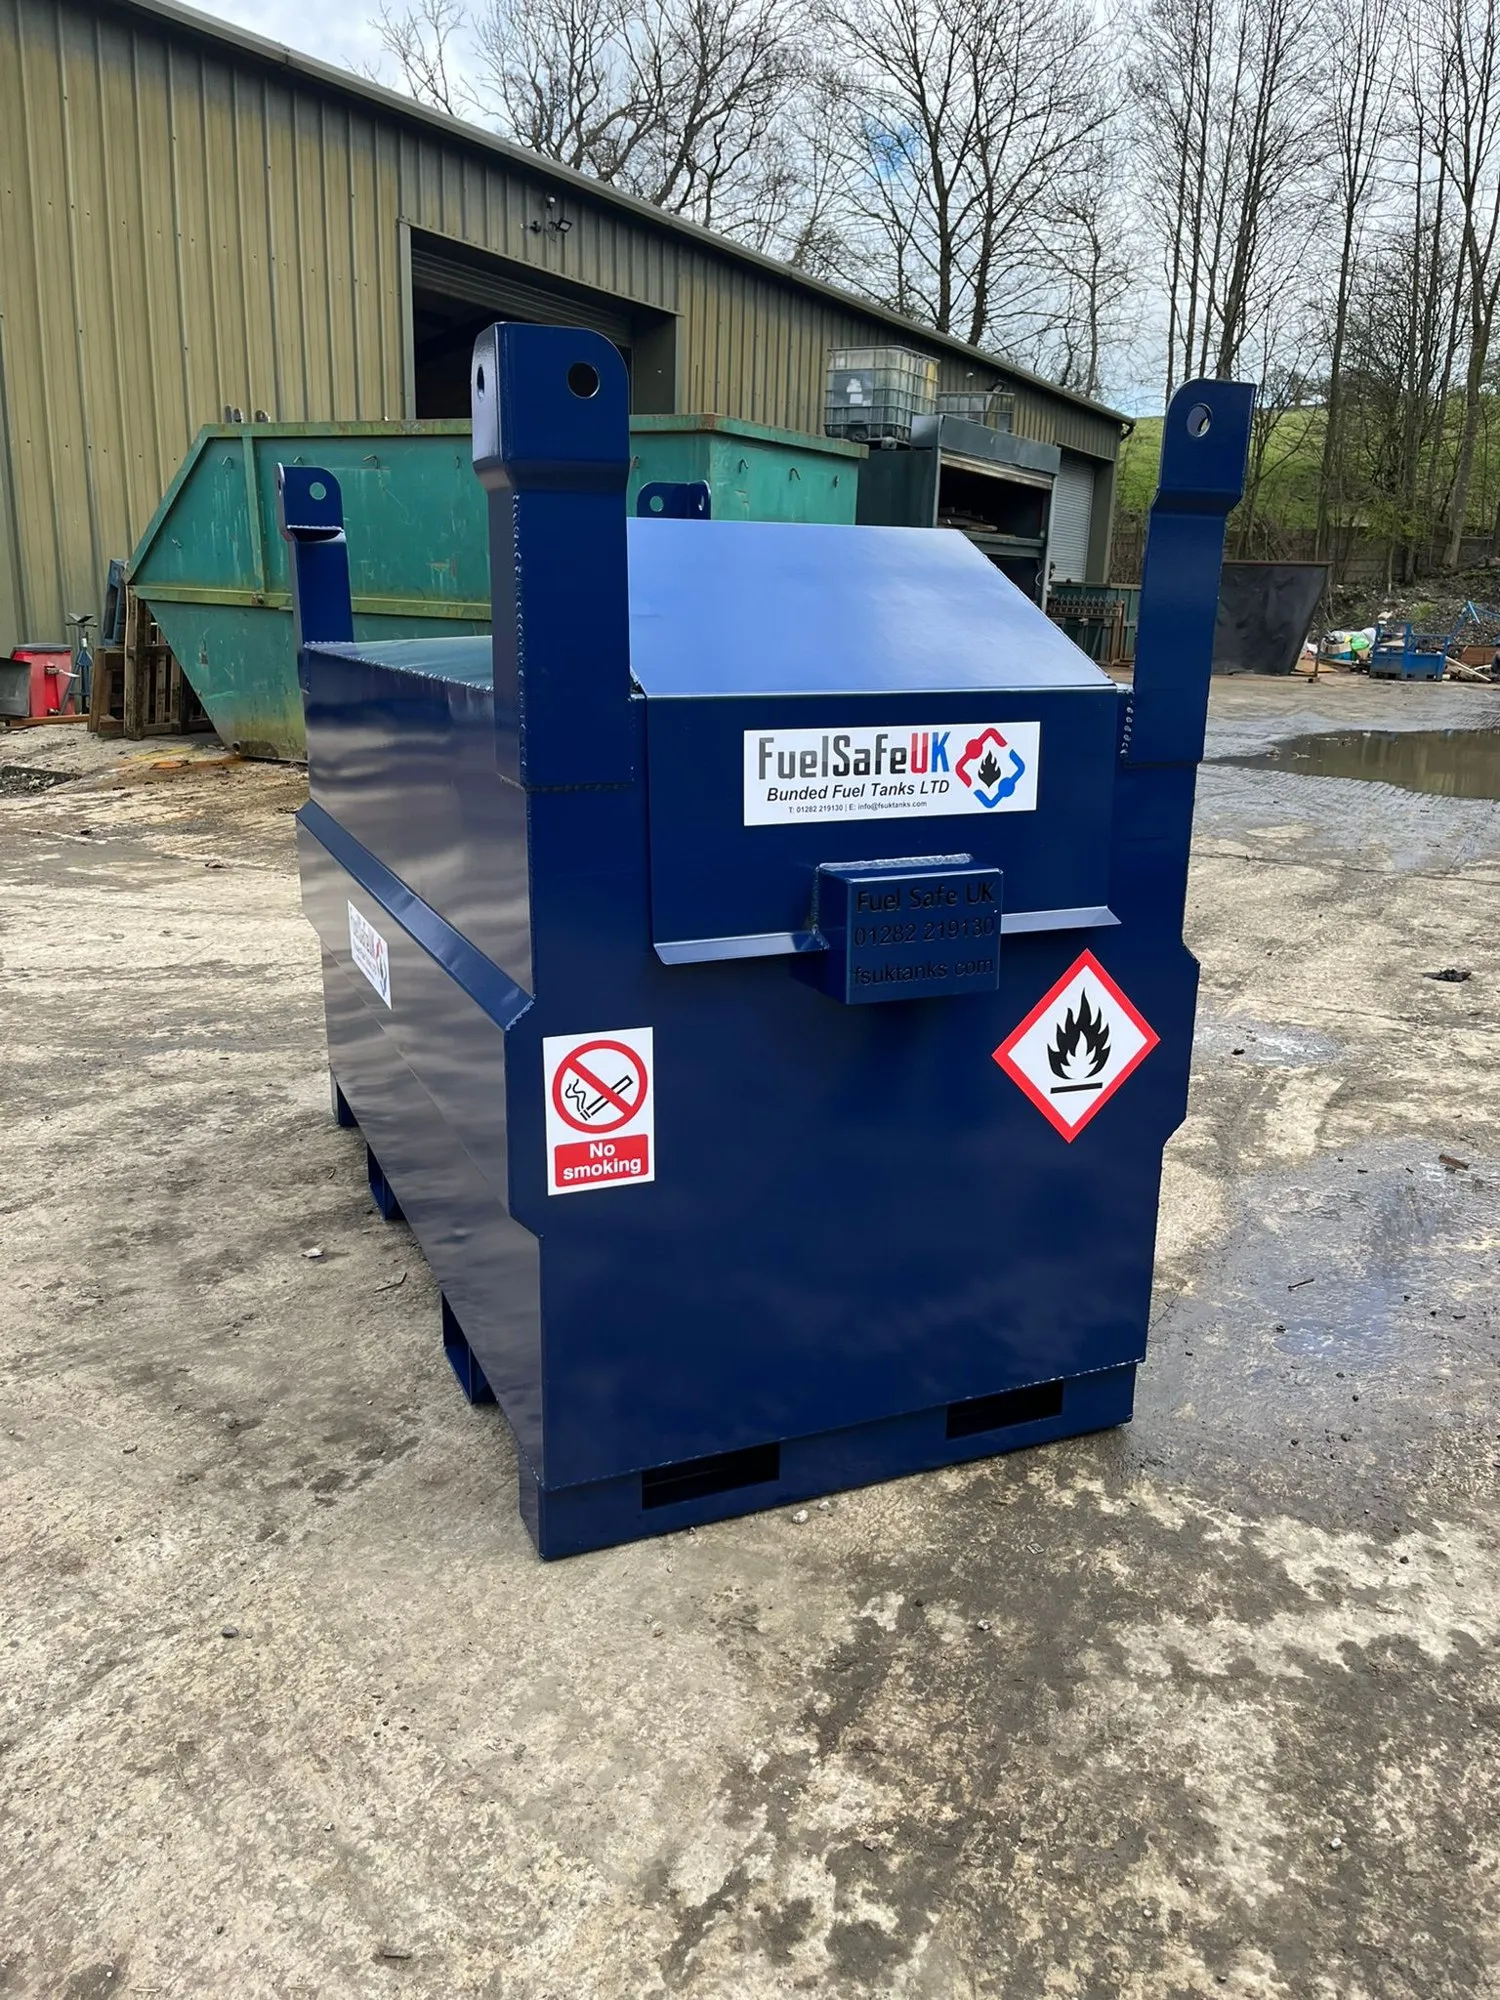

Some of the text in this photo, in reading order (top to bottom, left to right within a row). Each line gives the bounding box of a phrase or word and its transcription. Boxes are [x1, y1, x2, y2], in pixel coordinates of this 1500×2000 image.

[767, 780, 950, 801] Bunded Fuel Tanks LTD
[796, 805, 817, 813] 01282
[819, 804, 843, 812] 219130
[857, 801, 928, 811] info@fsuktanks.com
[856, 881, 997, 913] Fuel Safe UK
[854, 917, 995, 947] 01282 219130
[853, 961, 949, 986] fsuktanks
[589, 1142, 616, 1159] No
[562, 1157, 642, 1181] smoking
